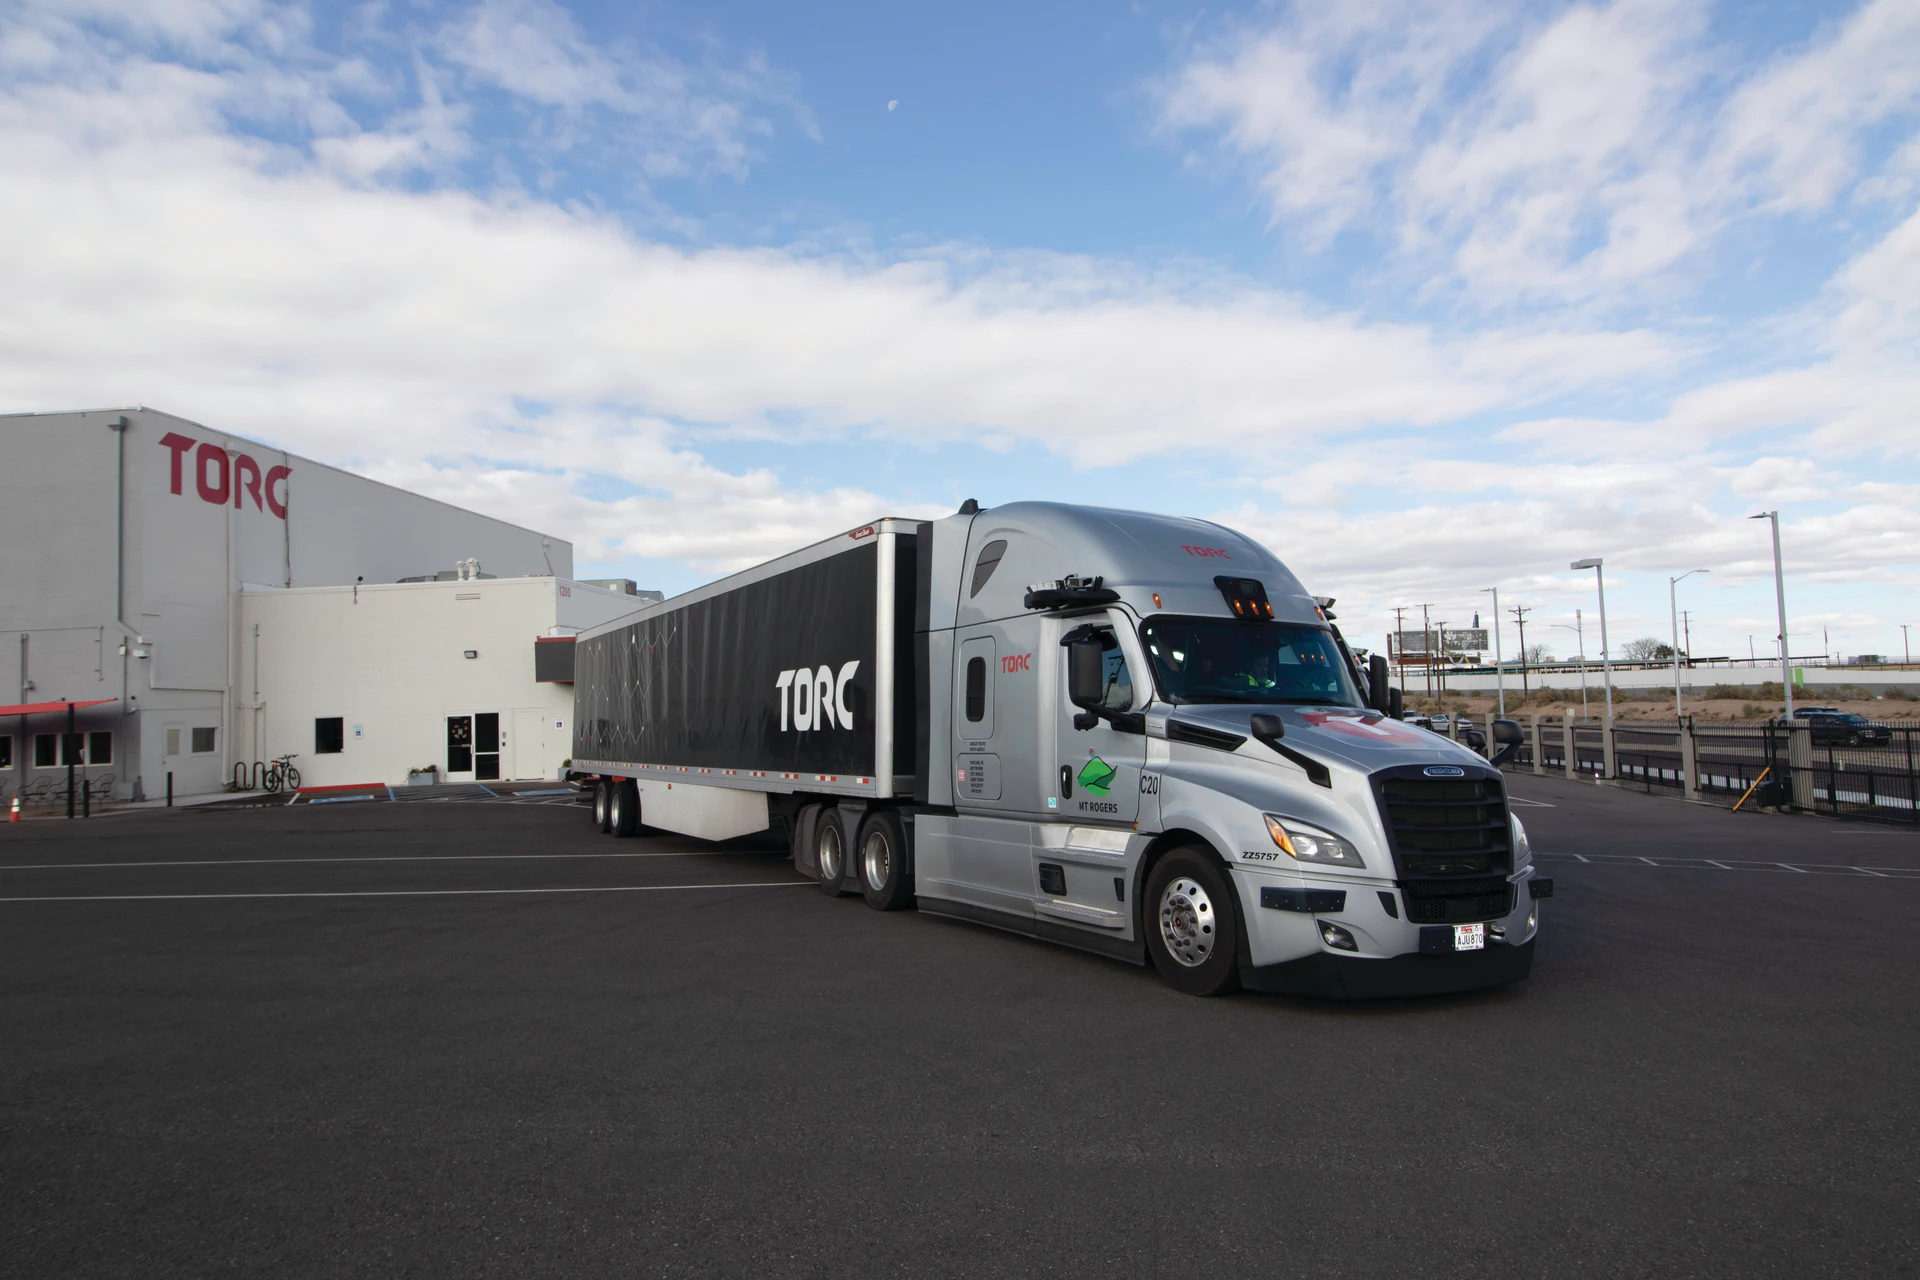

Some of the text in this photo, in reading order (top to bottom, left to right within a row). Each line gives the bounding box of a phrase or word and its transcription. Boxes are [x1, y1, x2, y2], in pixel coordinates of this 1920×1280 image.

[158, 431, 294, 521] TORC
[1180, 545, 1232, 560] TORC
[559, 585, 572, 598] 1200
[1001, 652, 1032, 674] TORC
[775, 660, 860, 732] TORC
[1140, 775, 1158, 795] C20
[1078, 801, 1118, 814] MT ROGERS
[1241, 851, 1279, 861] ZZ5757
[1457, 933, 1483, 946] AJU870
